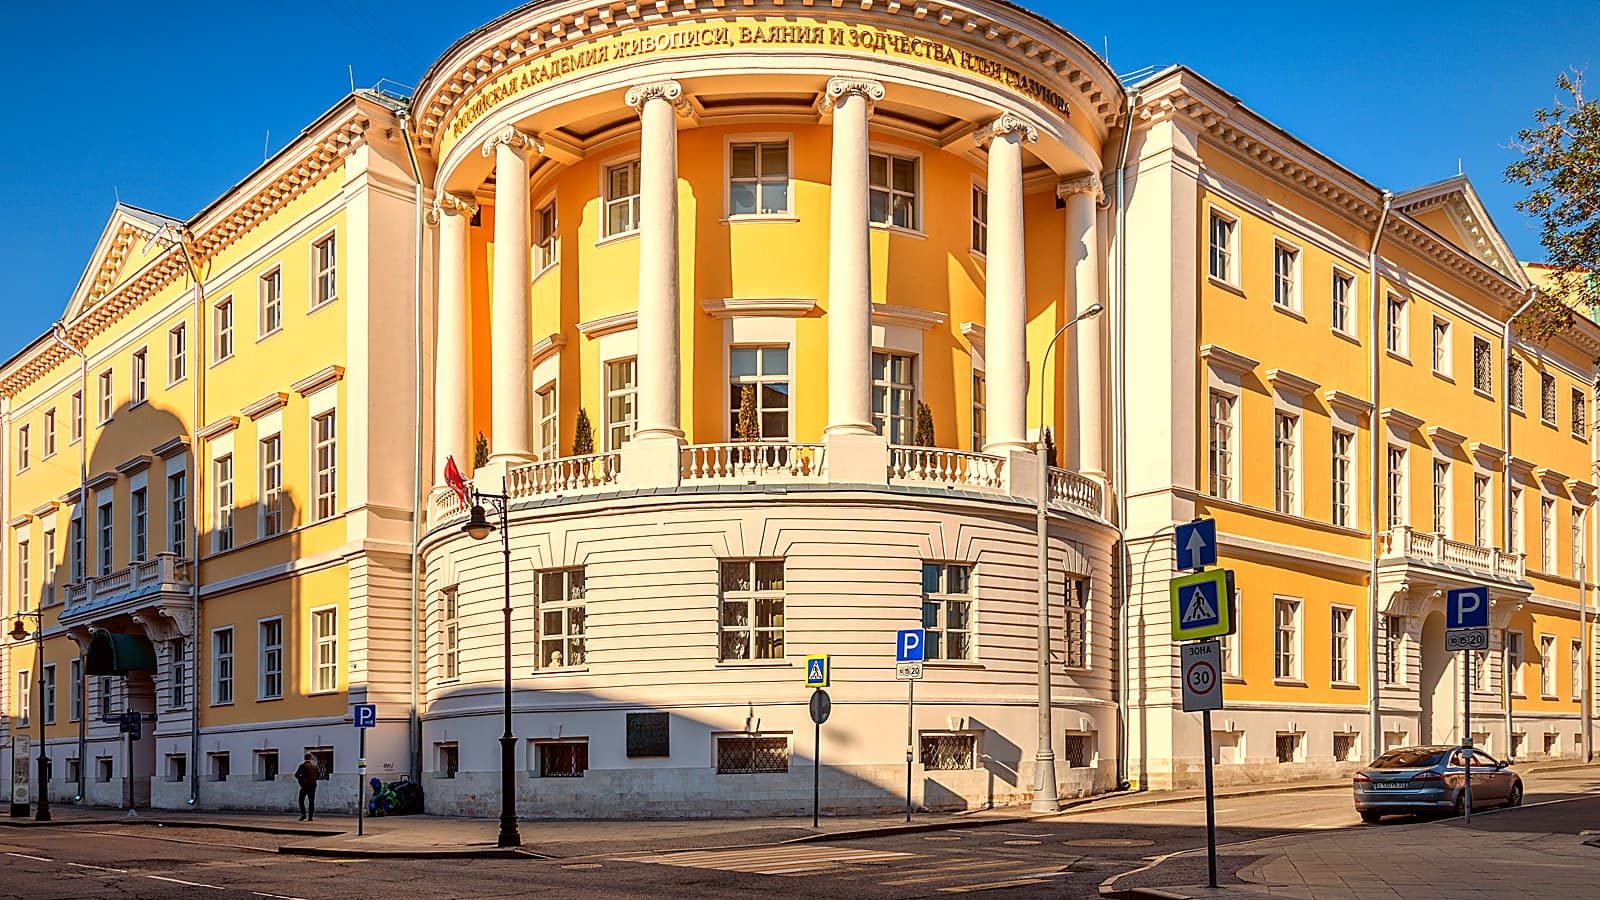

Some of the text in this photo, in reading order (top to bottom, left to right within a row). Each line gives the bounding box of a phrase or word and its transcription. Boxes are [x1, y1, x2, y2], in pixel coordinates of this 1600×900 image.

[520, 45, 608, 89] АКАДЕМИЯ
[613, 27, 734, 59] ЖИВОПИСИ,
[739, 25, 824, 44] ВАЯНИЯ
[829, 27, 844, 46] И
[850, 29, 957, 67] ЗОДЧЕСТВА
[960, 50, 1001, 81] ИЛЬИ
[1003, 66, 1071, 118] ГЛАЗУНОВА
[1458, 592, 1480, 624] P
[904, 632, 919, 658] P
[1470, 635, 1482, 644] 20
[1189, 645, 1212, 656] ЗОНА
[1193, 672, 1209, 685] 30
[360, 707, 372, 725] P
